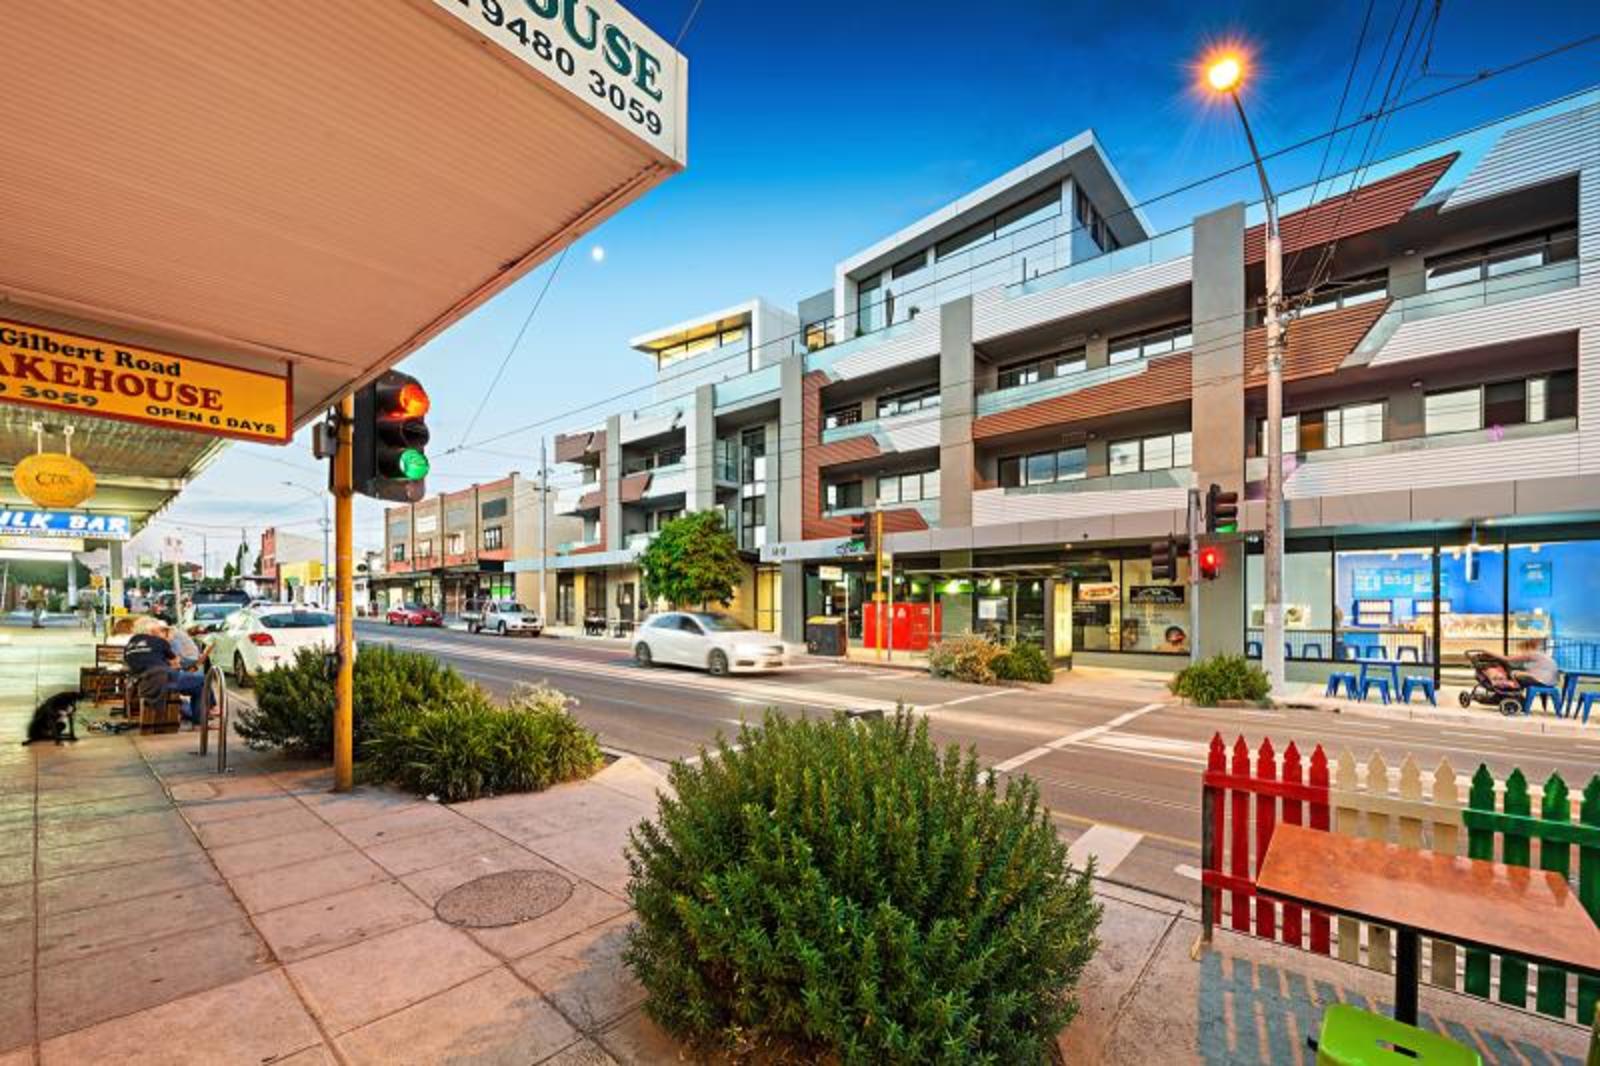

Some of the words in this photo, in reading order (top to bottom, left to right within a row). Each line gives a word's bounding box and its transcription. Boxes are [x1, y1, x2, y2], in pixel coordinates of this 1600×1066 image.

[481, 0, 575, 76] 9480
[588, 70, 662, 135] 3059
[0, 327, 104, 362] Gilbert
[115, 350, 181, 377] Road
[20, 385, 98, 406] 3059
[146, 405, 202, 422] OPEN
[209, 415, 221, 425] 6
[227, 417, 276, 433] DAYS
[69, 514, 128, 533] BAR
